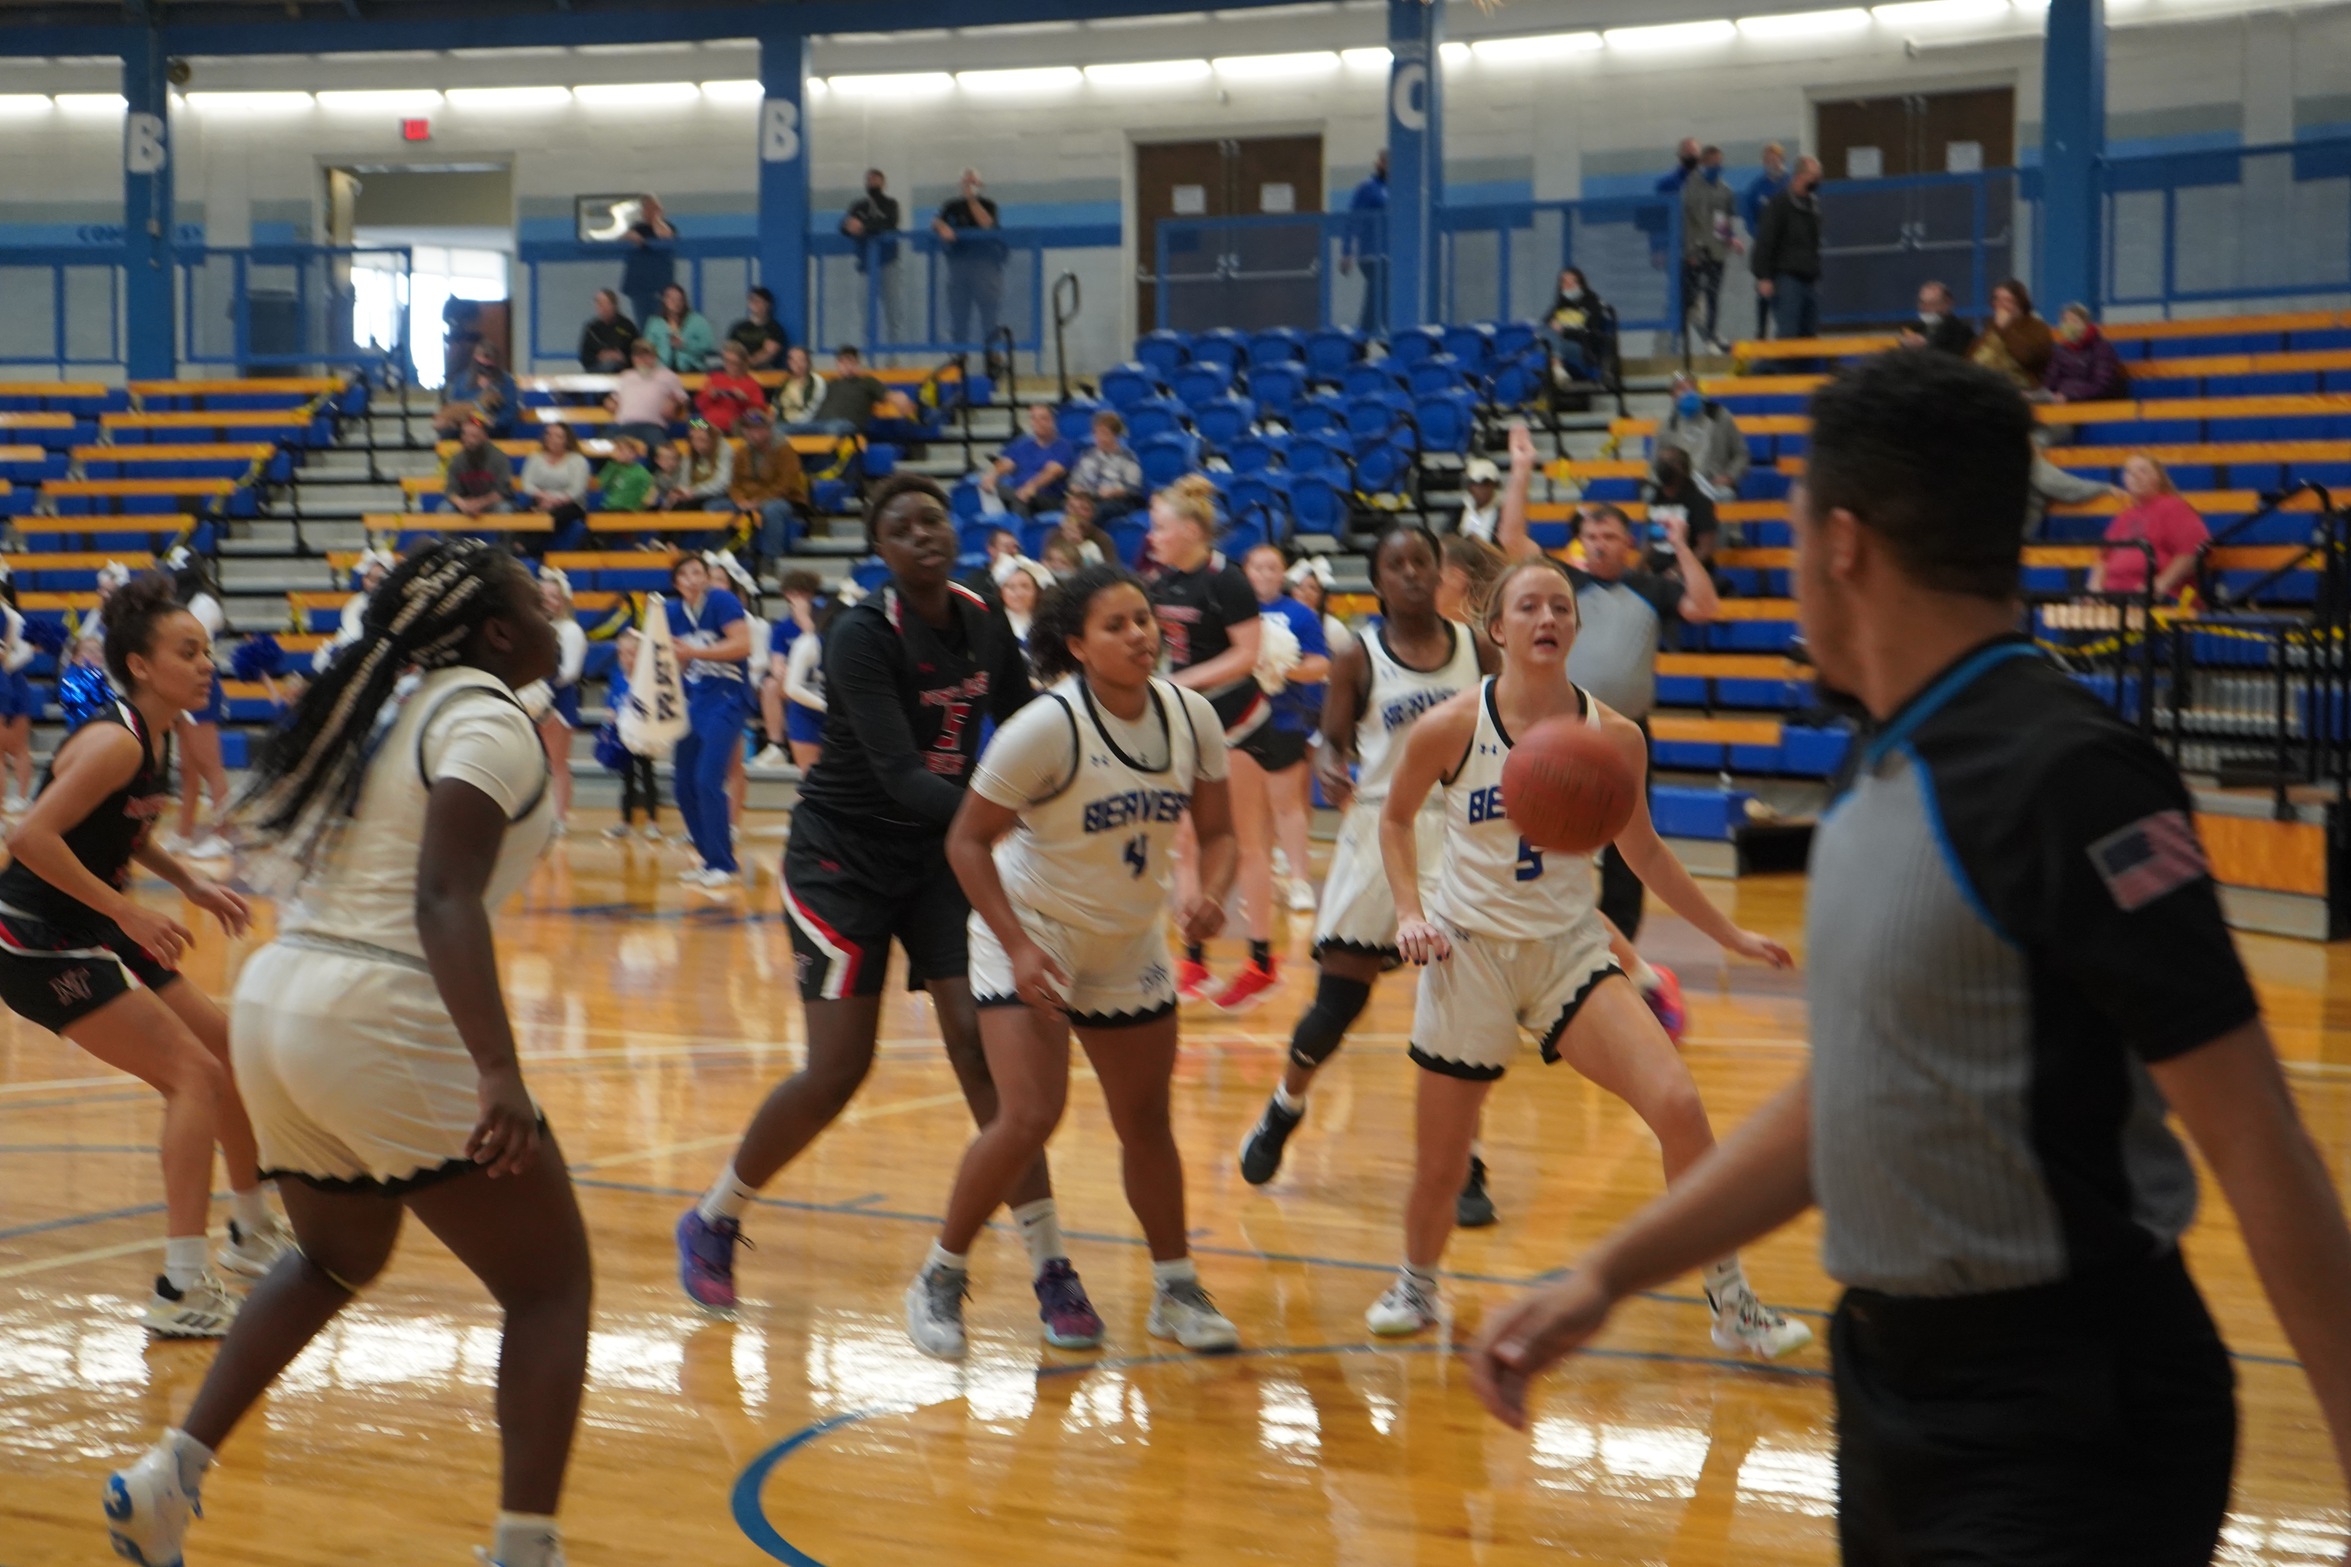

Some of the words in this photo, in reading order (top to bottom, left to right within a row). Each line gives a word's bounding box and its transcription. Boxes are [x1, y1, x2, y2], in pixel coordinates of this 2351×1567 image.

[126, 112, 167, 173] B
[762, 98, 799, 161] B
[1124, 832, 1149, 879] 4
